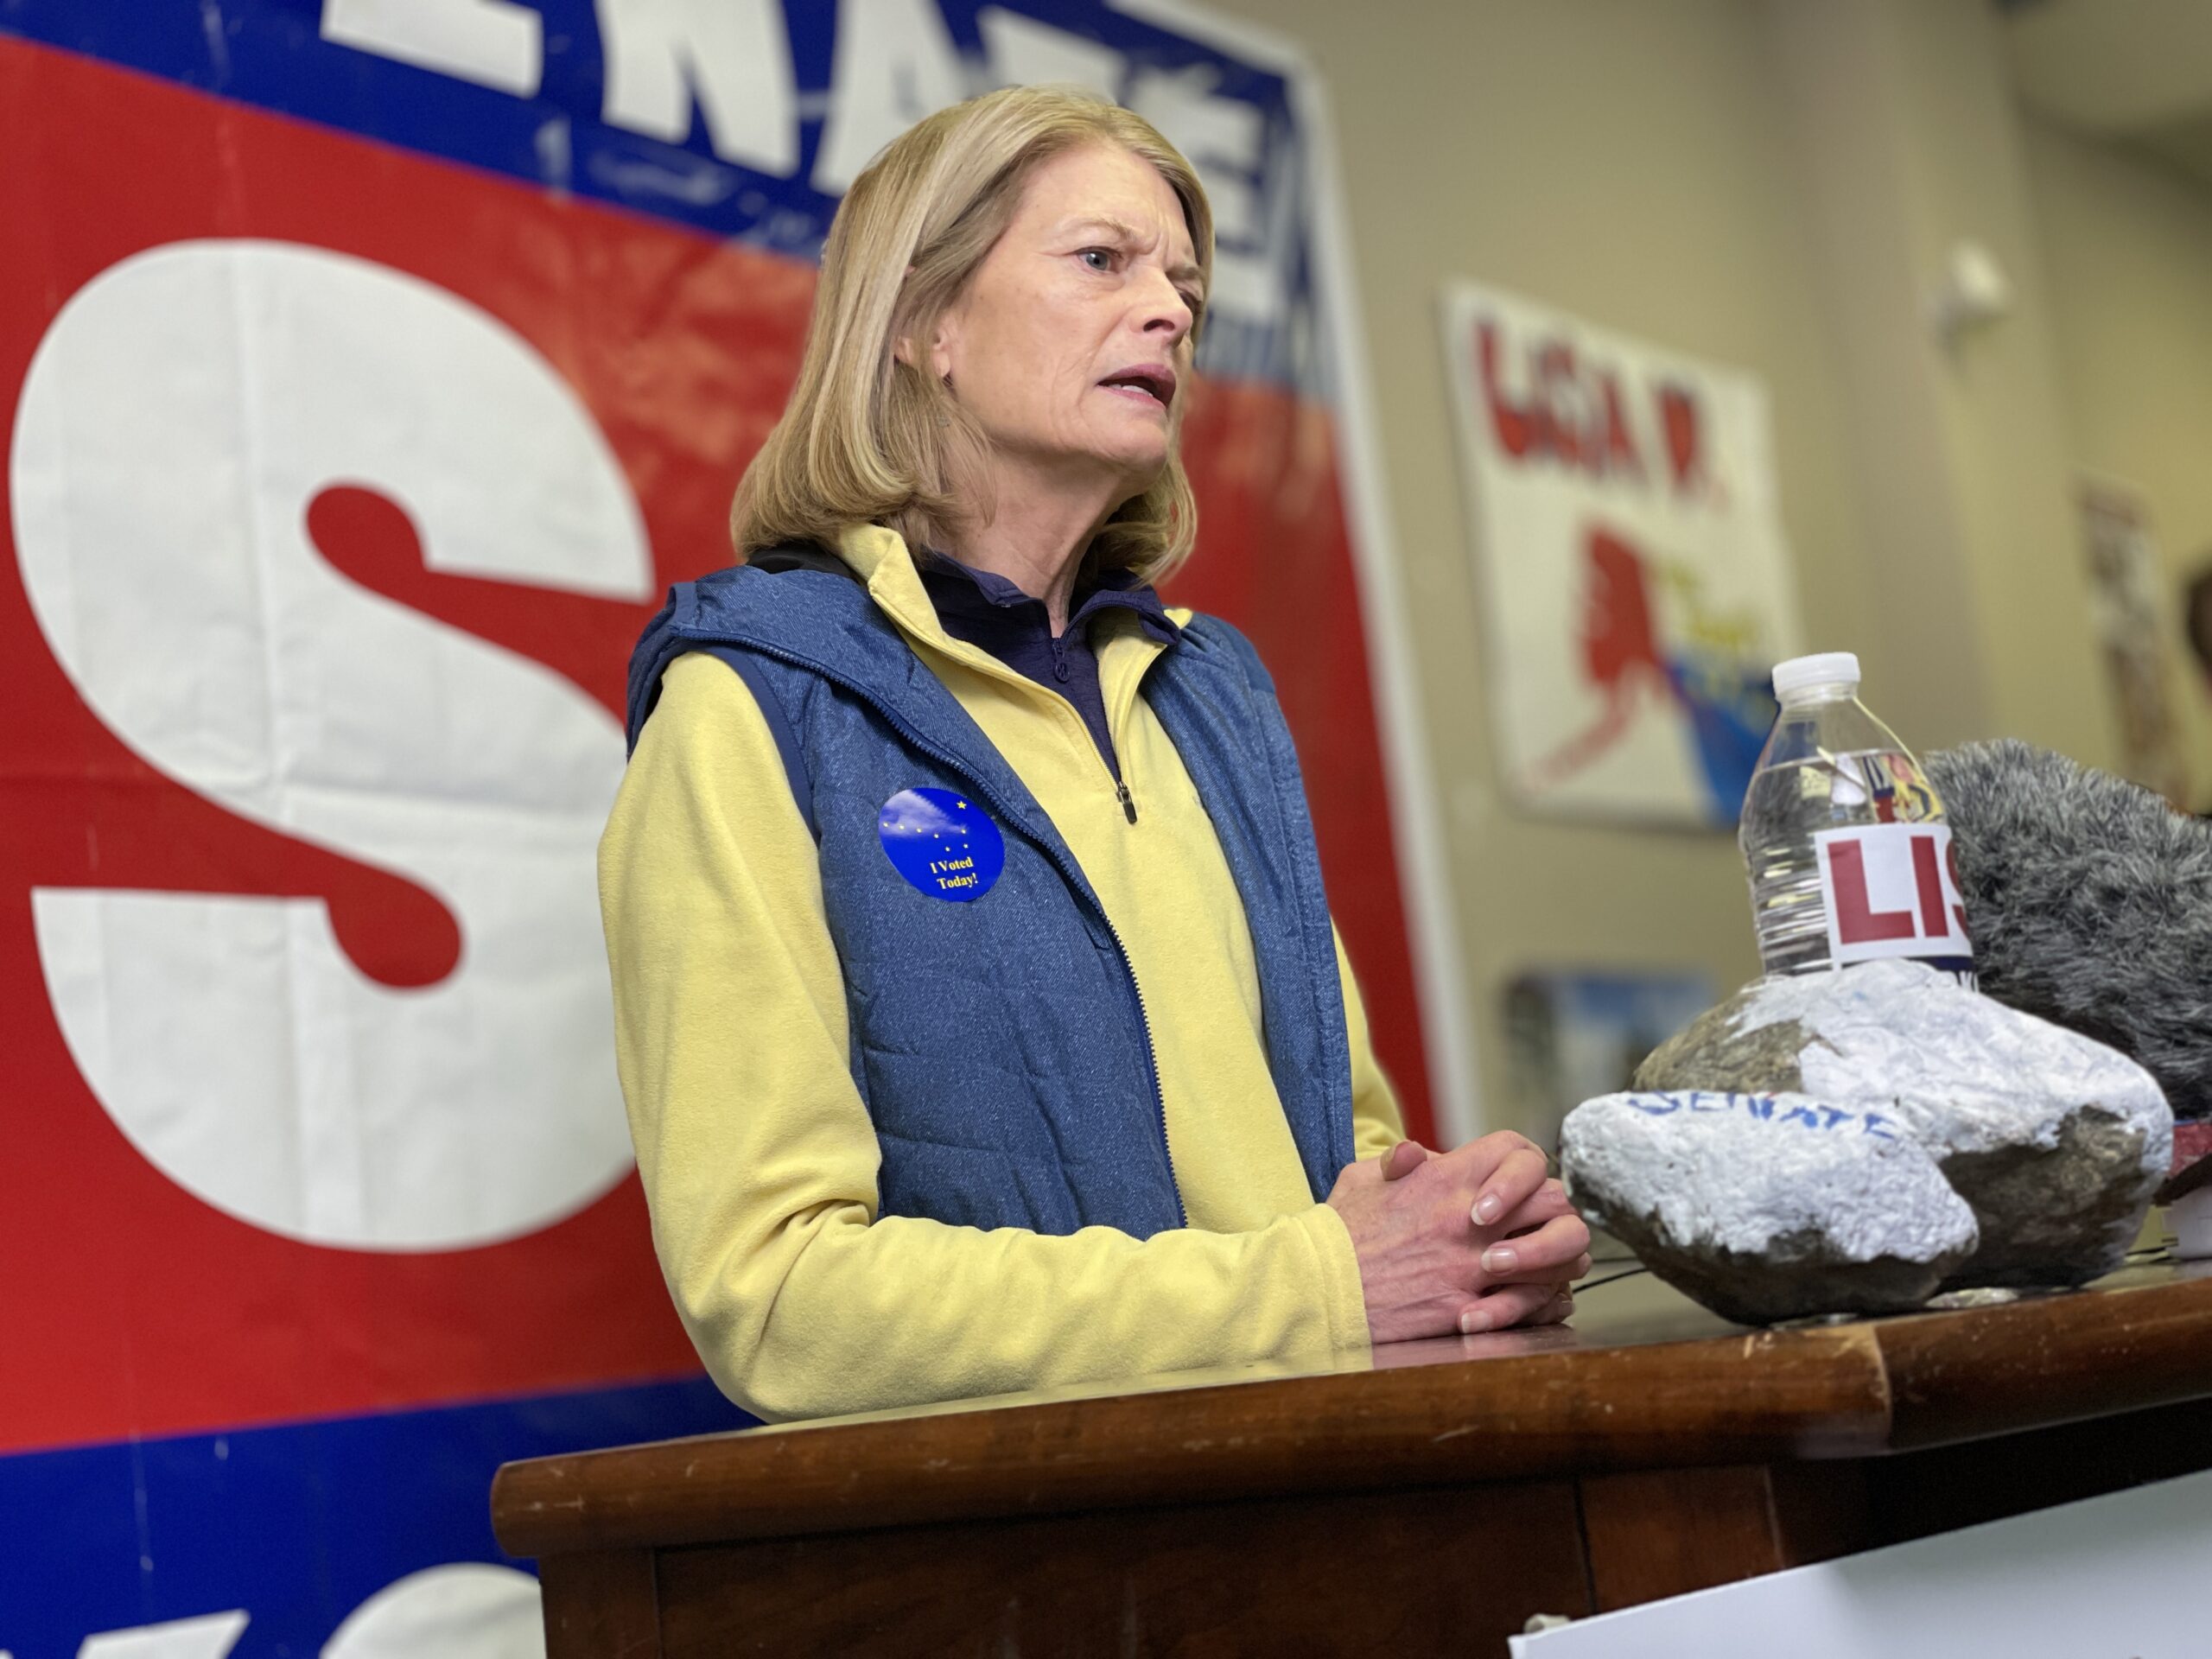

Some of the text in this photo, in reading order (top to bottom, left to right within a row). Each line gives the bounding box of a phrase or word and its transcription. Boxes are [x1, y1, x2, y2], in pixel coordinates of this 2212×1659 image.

[930, 856, 973, 874] I Voted
[938, 873, 978, 889] Today!
